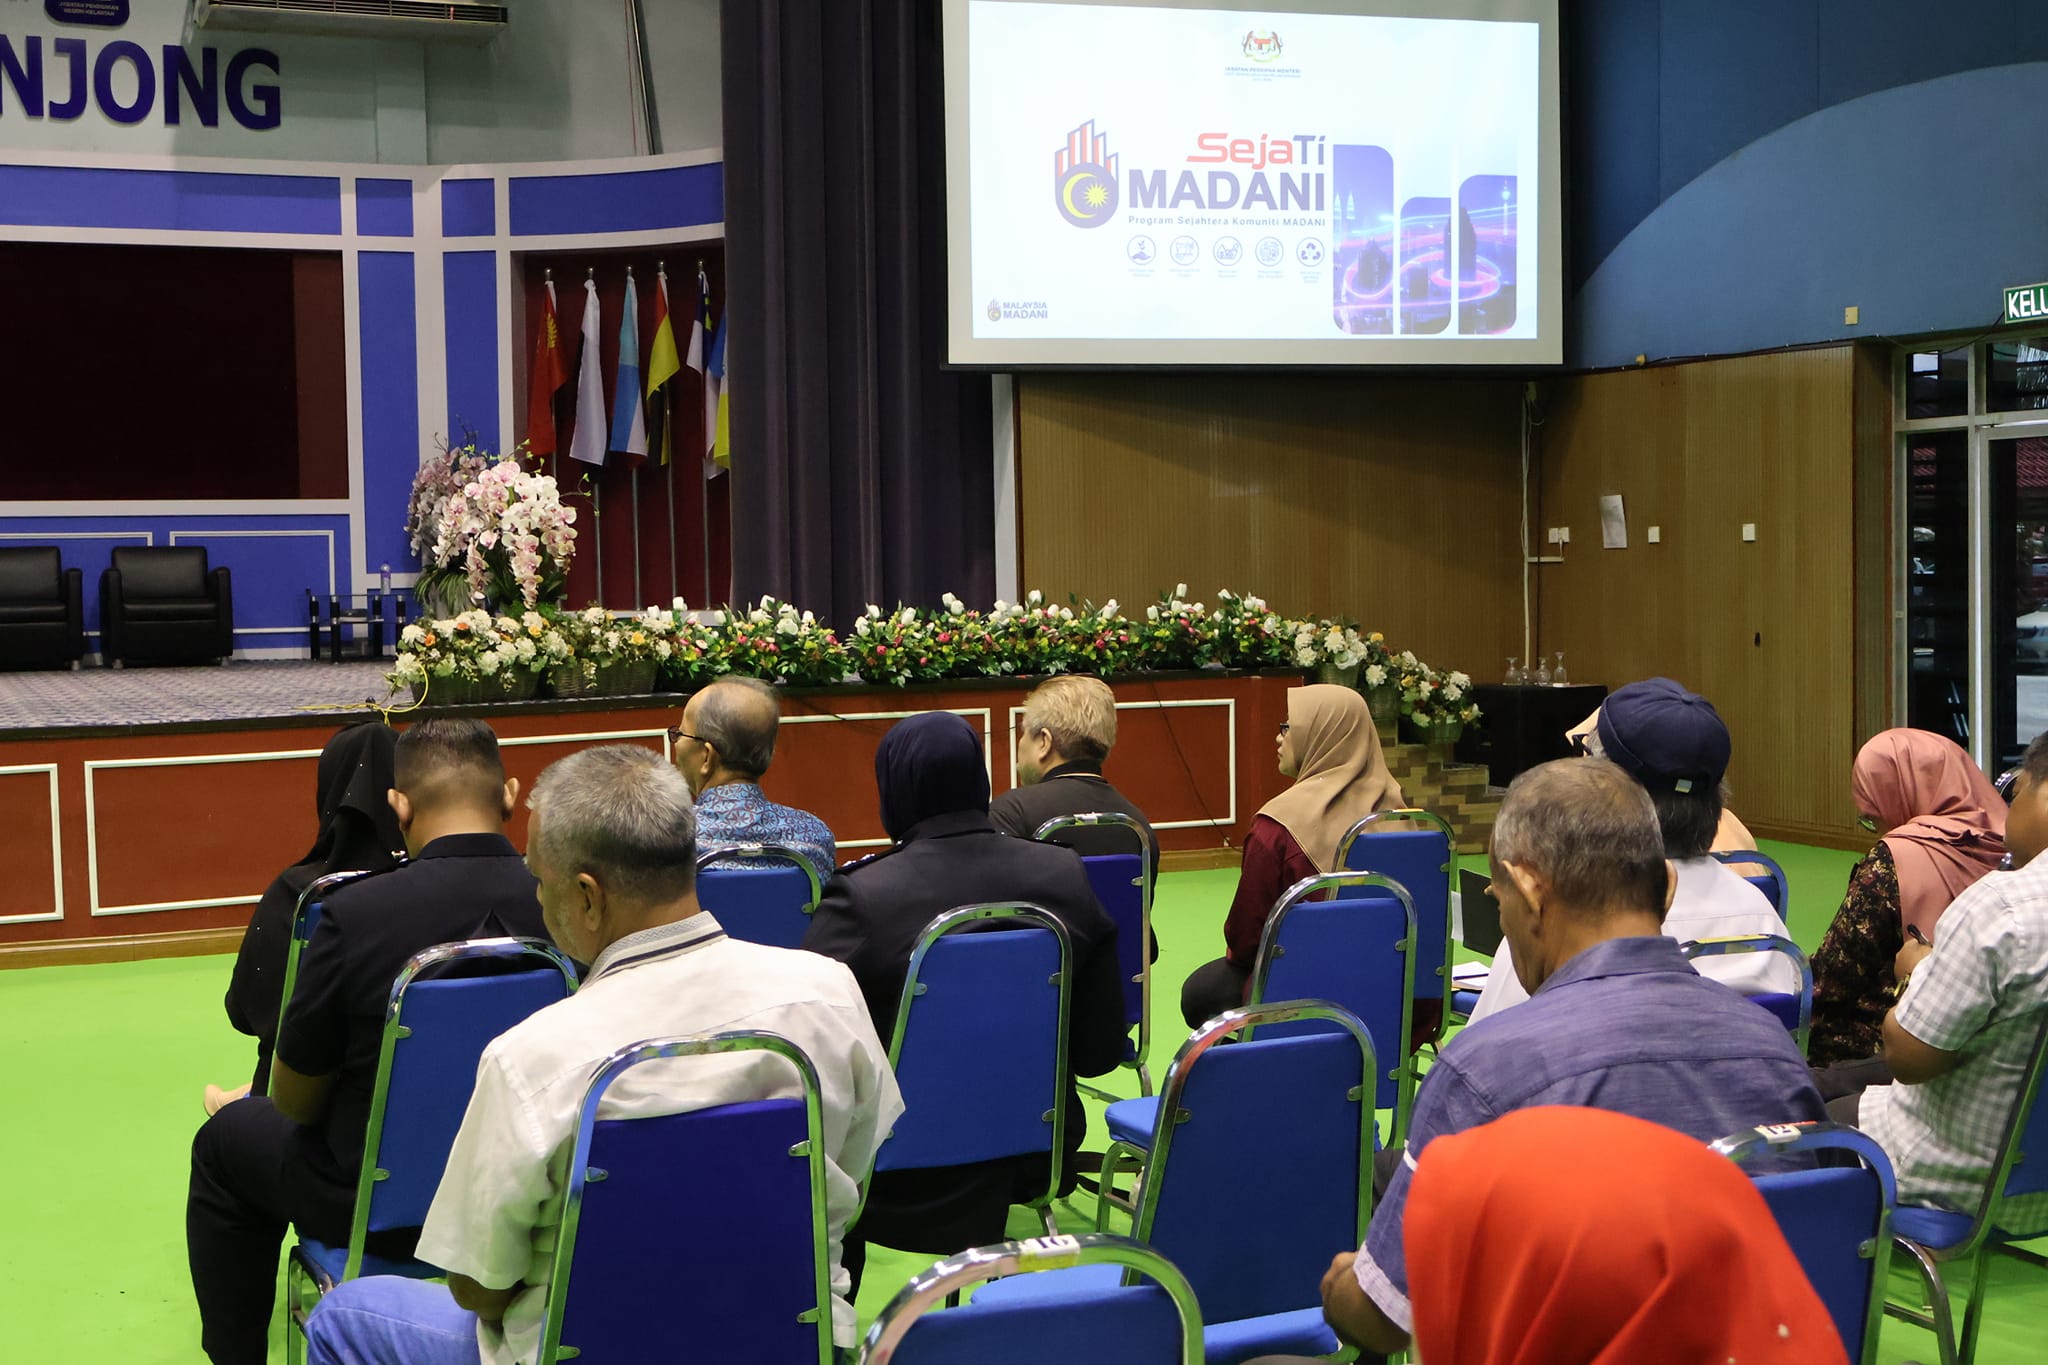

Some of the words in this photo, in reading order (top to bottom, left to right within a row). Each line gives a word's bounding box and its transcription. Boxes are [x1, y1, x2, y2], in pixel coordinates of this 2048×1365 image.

[1128, 168, 1325, 211] MADANI
[1128, 215, 1174, 227] Program
[1177, 215, 1229, 227] Sejahtera
[1232, 217, 1279, 226] Komuniti
[1282, 218, 1326, 227] MADANI
[1002, 309, 1048, 319] MADANI
